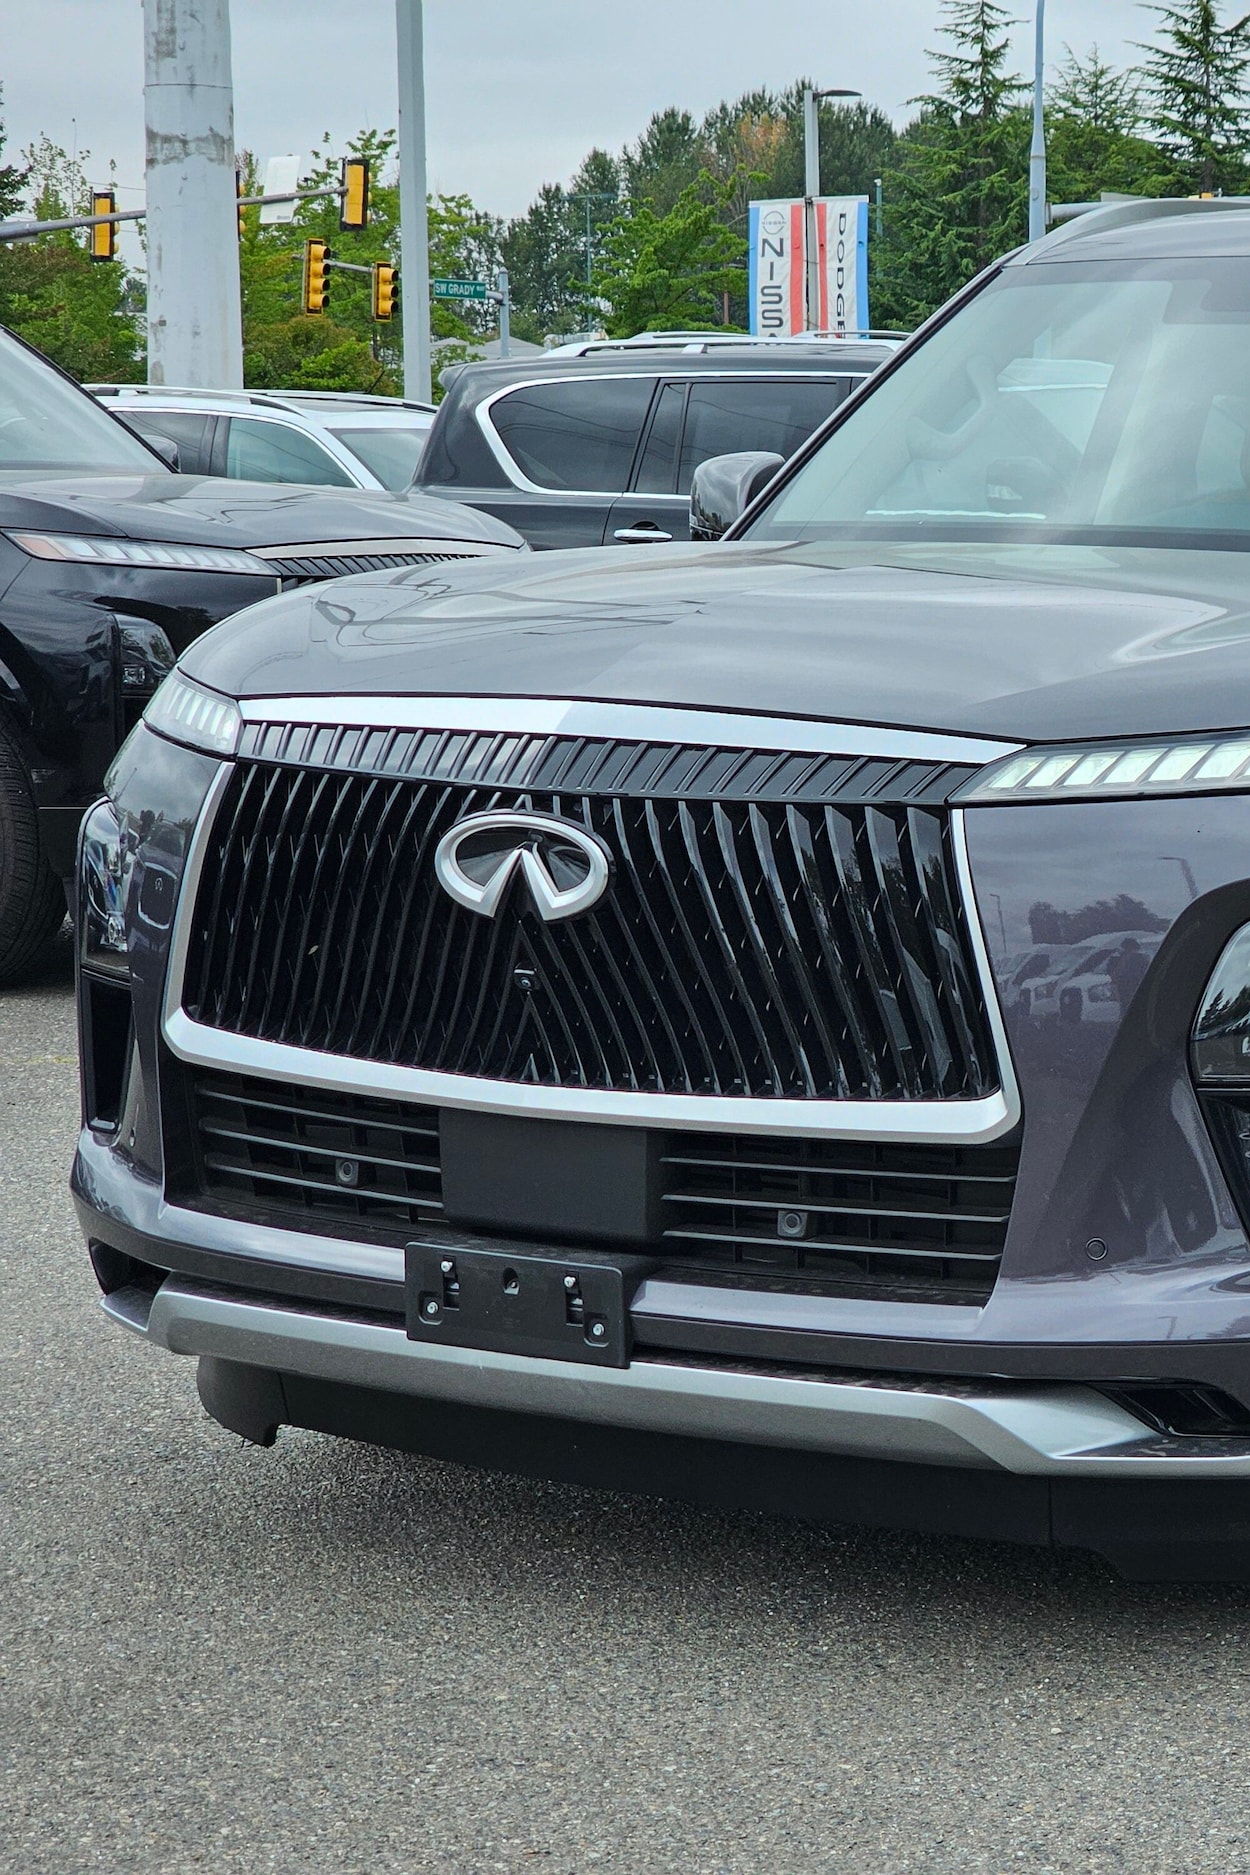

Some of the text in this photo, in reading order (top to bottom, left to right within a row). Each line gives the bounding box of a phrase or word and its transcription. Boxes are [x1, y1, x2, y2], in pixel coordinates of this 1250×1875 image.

[435, 282, 447, 294] SW
[448, 283, 475, 296] GRADY
[761, 238, 784, 337] NISS
[836, 213, 847, 338] DODGE
